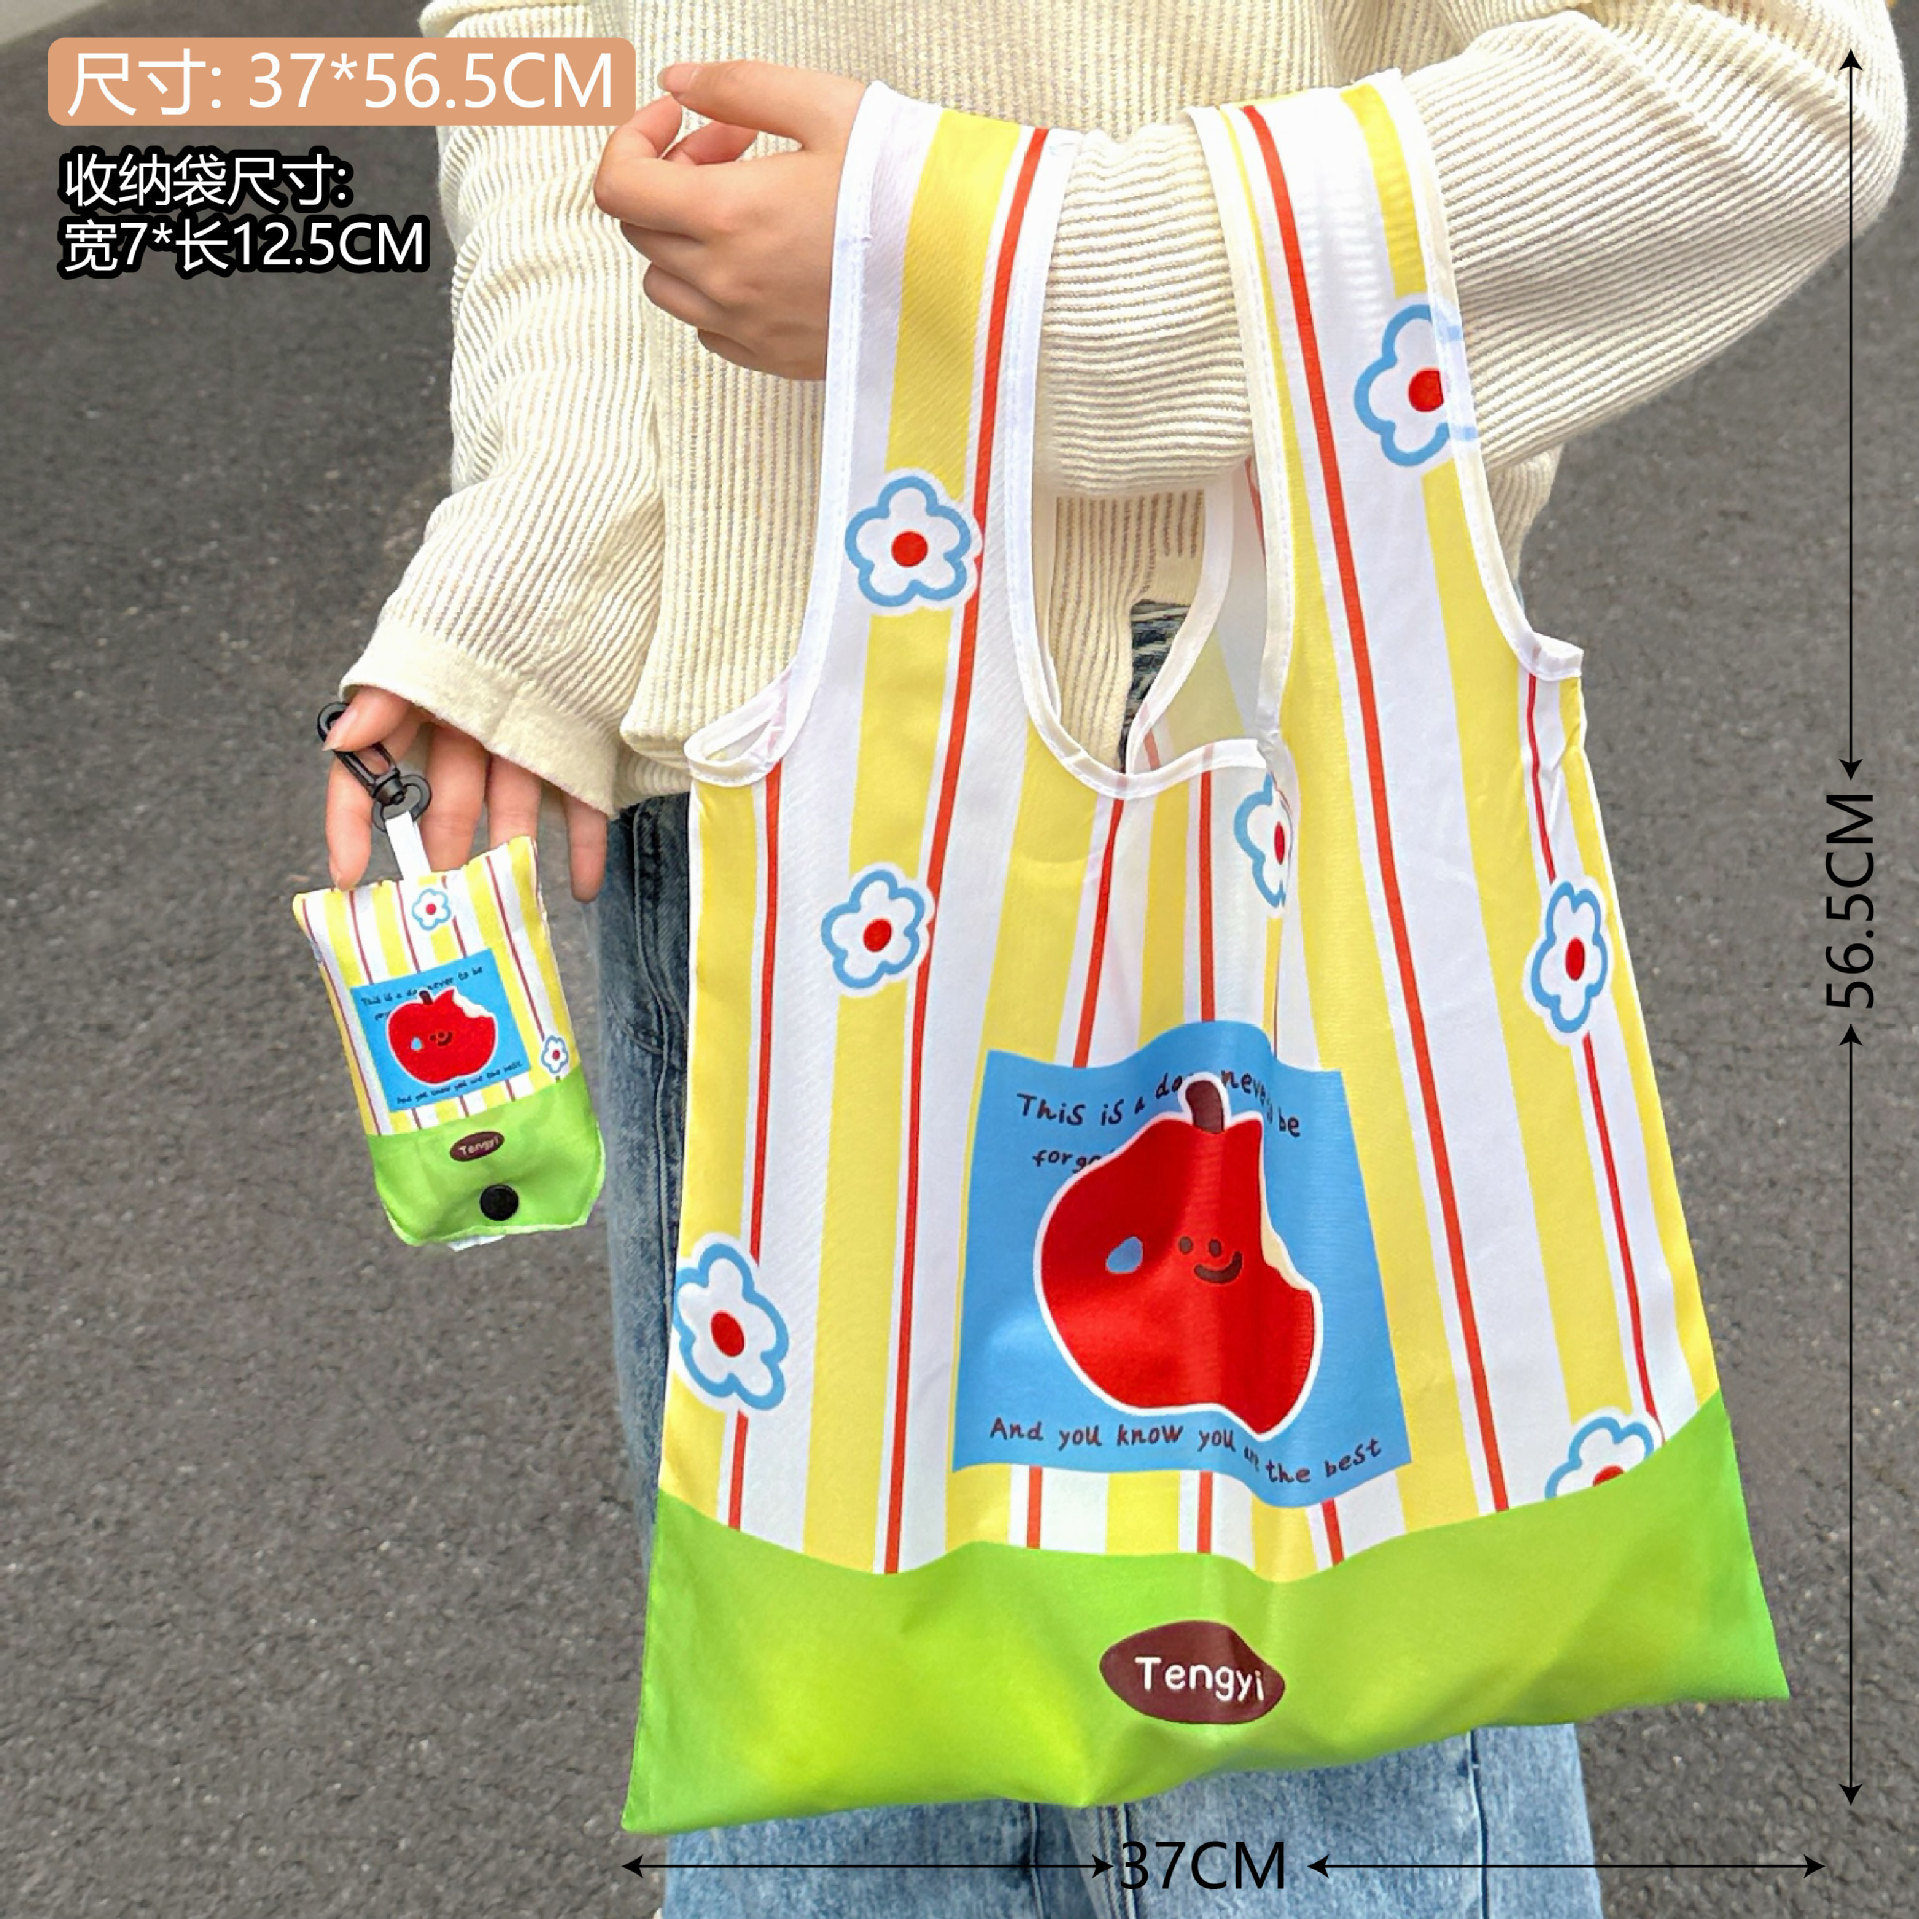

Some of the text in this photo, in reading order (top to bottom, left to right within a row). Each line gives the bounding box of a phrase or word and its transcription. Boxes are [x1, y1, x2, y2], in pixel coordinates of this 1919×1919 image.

[1016, 1092, 1086, 1126] This
[1101, 1098, 1125, 1126] is
[1278, 1105, 1301, 1138] be
[990, 1416, 1382, 1483] And you know you the best
[1134, 1656, 1265, 1703] Tengyi
